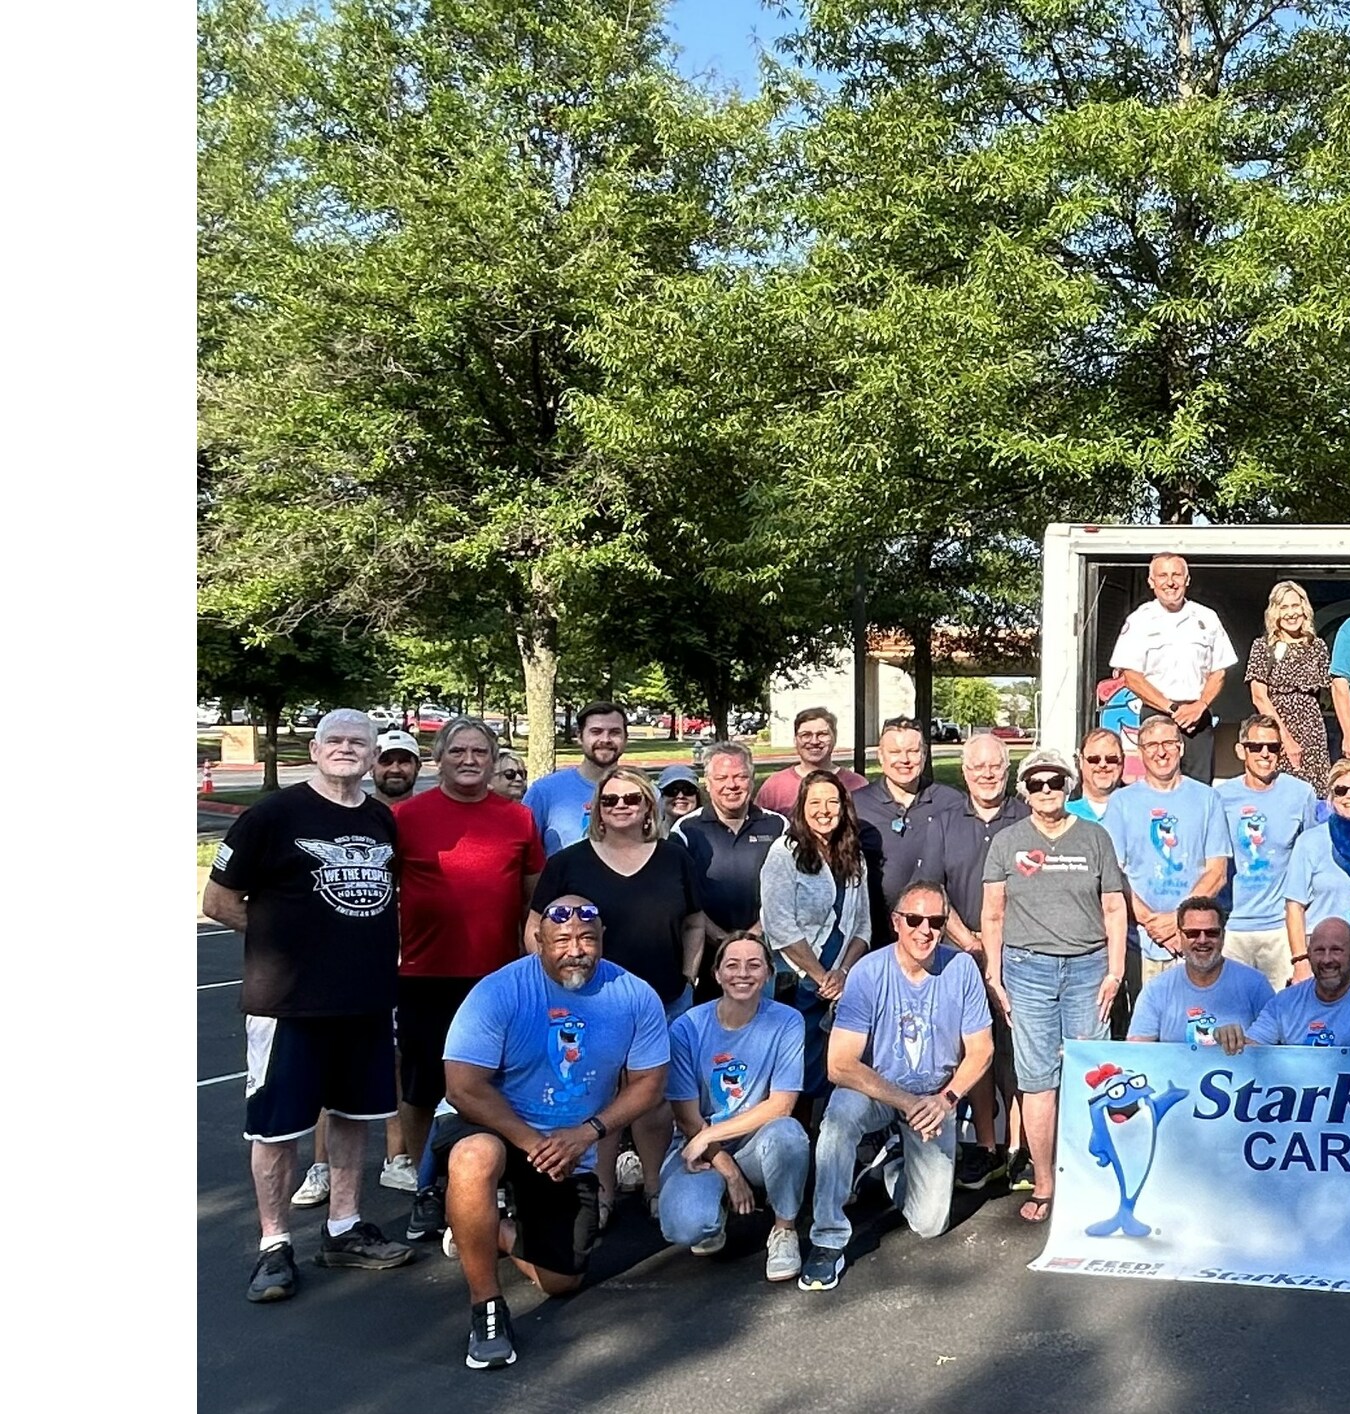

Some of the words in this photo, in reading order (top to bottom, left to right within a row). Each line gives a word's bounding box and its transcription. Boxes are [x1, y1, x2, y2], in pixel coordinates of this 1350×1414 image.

[324, 869, 341, 883] WE
[341, 868, 361, 881] THE
[1088, 1259, 1152, 1271] FEED
